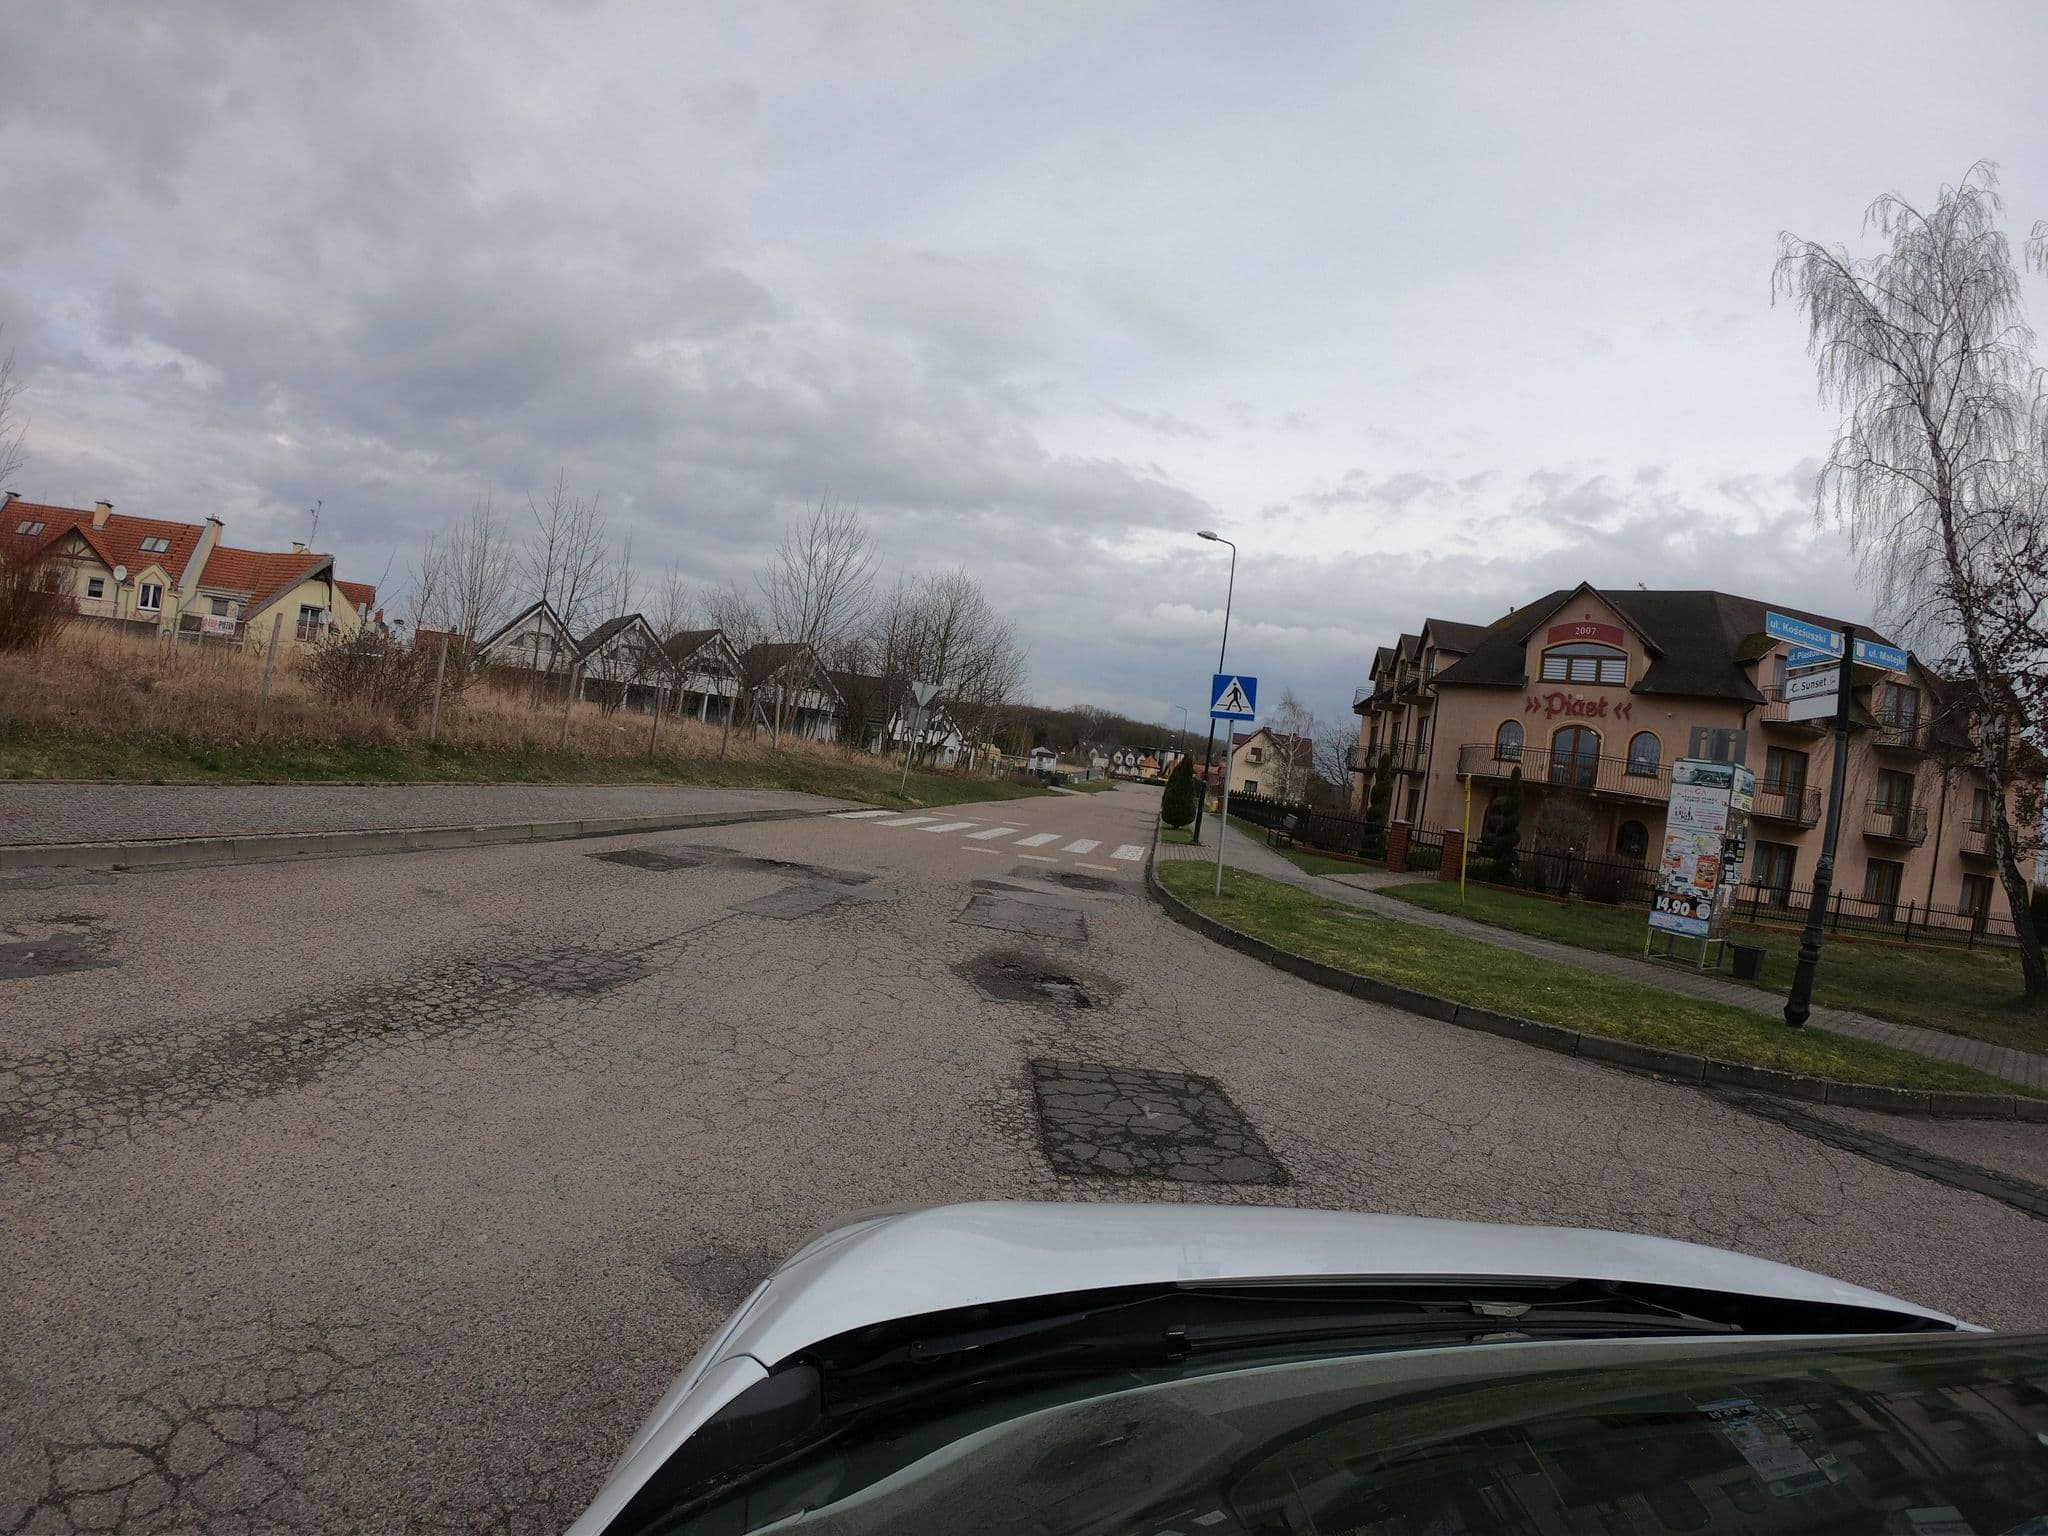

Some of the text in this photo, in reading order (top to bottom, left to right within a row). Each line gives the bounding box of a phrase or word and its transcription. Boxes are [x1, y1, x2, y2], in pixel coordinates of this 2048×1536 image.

[1575, 626, 1597, 635] 2007
[1770, 620, 1826, 643] ul. Kościuszki
[1879, 651, 1905, 666] Matejki
[1800, 678, 1827, 692] Sunset
[1543, 692, 1609, 720] Piast
[1656, 896, 1690, 917] 14,90
